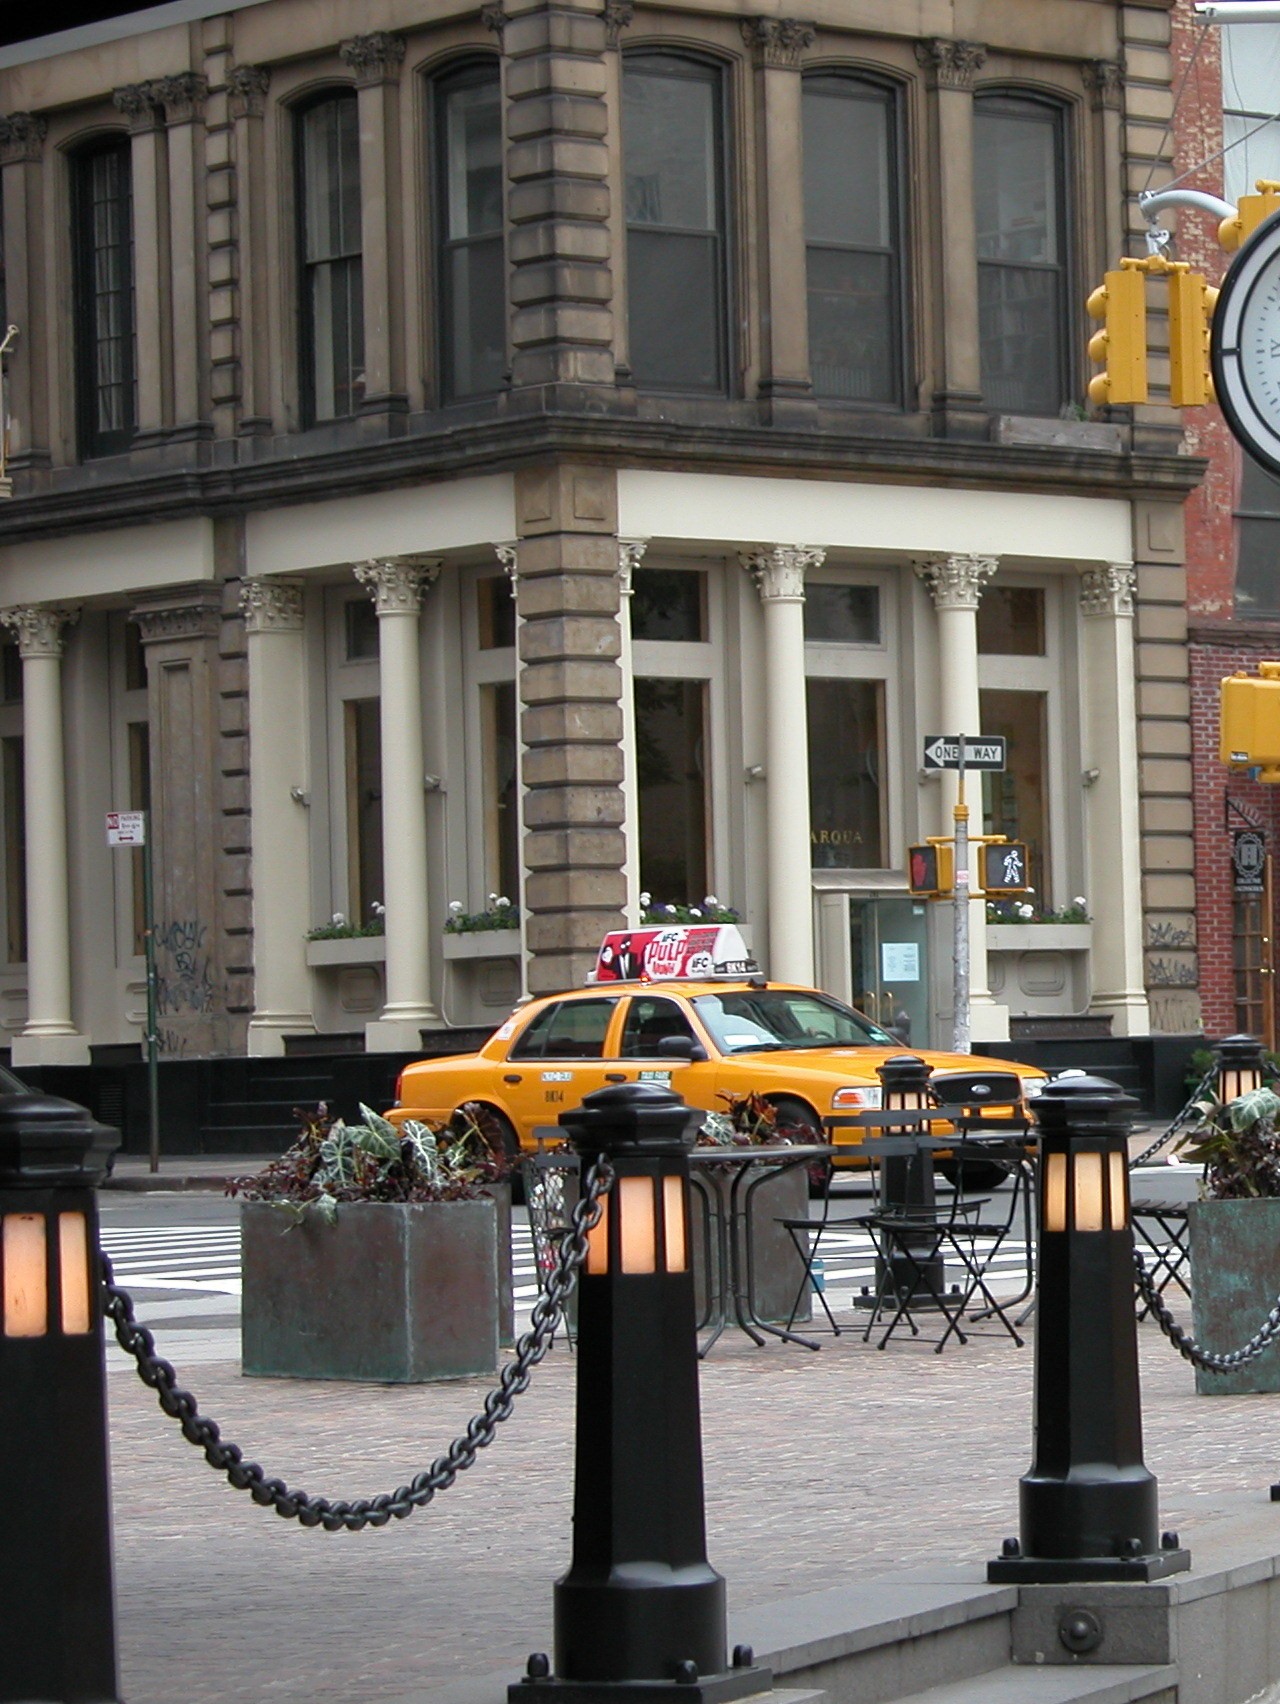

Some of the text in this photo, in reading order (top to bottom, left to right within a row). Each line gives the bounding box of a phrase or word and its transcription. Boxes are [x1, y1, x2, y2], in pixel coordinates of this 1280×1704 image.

[935, 746, 999, 760] ONE WAY
[648, 940, 688, 965] PULP
